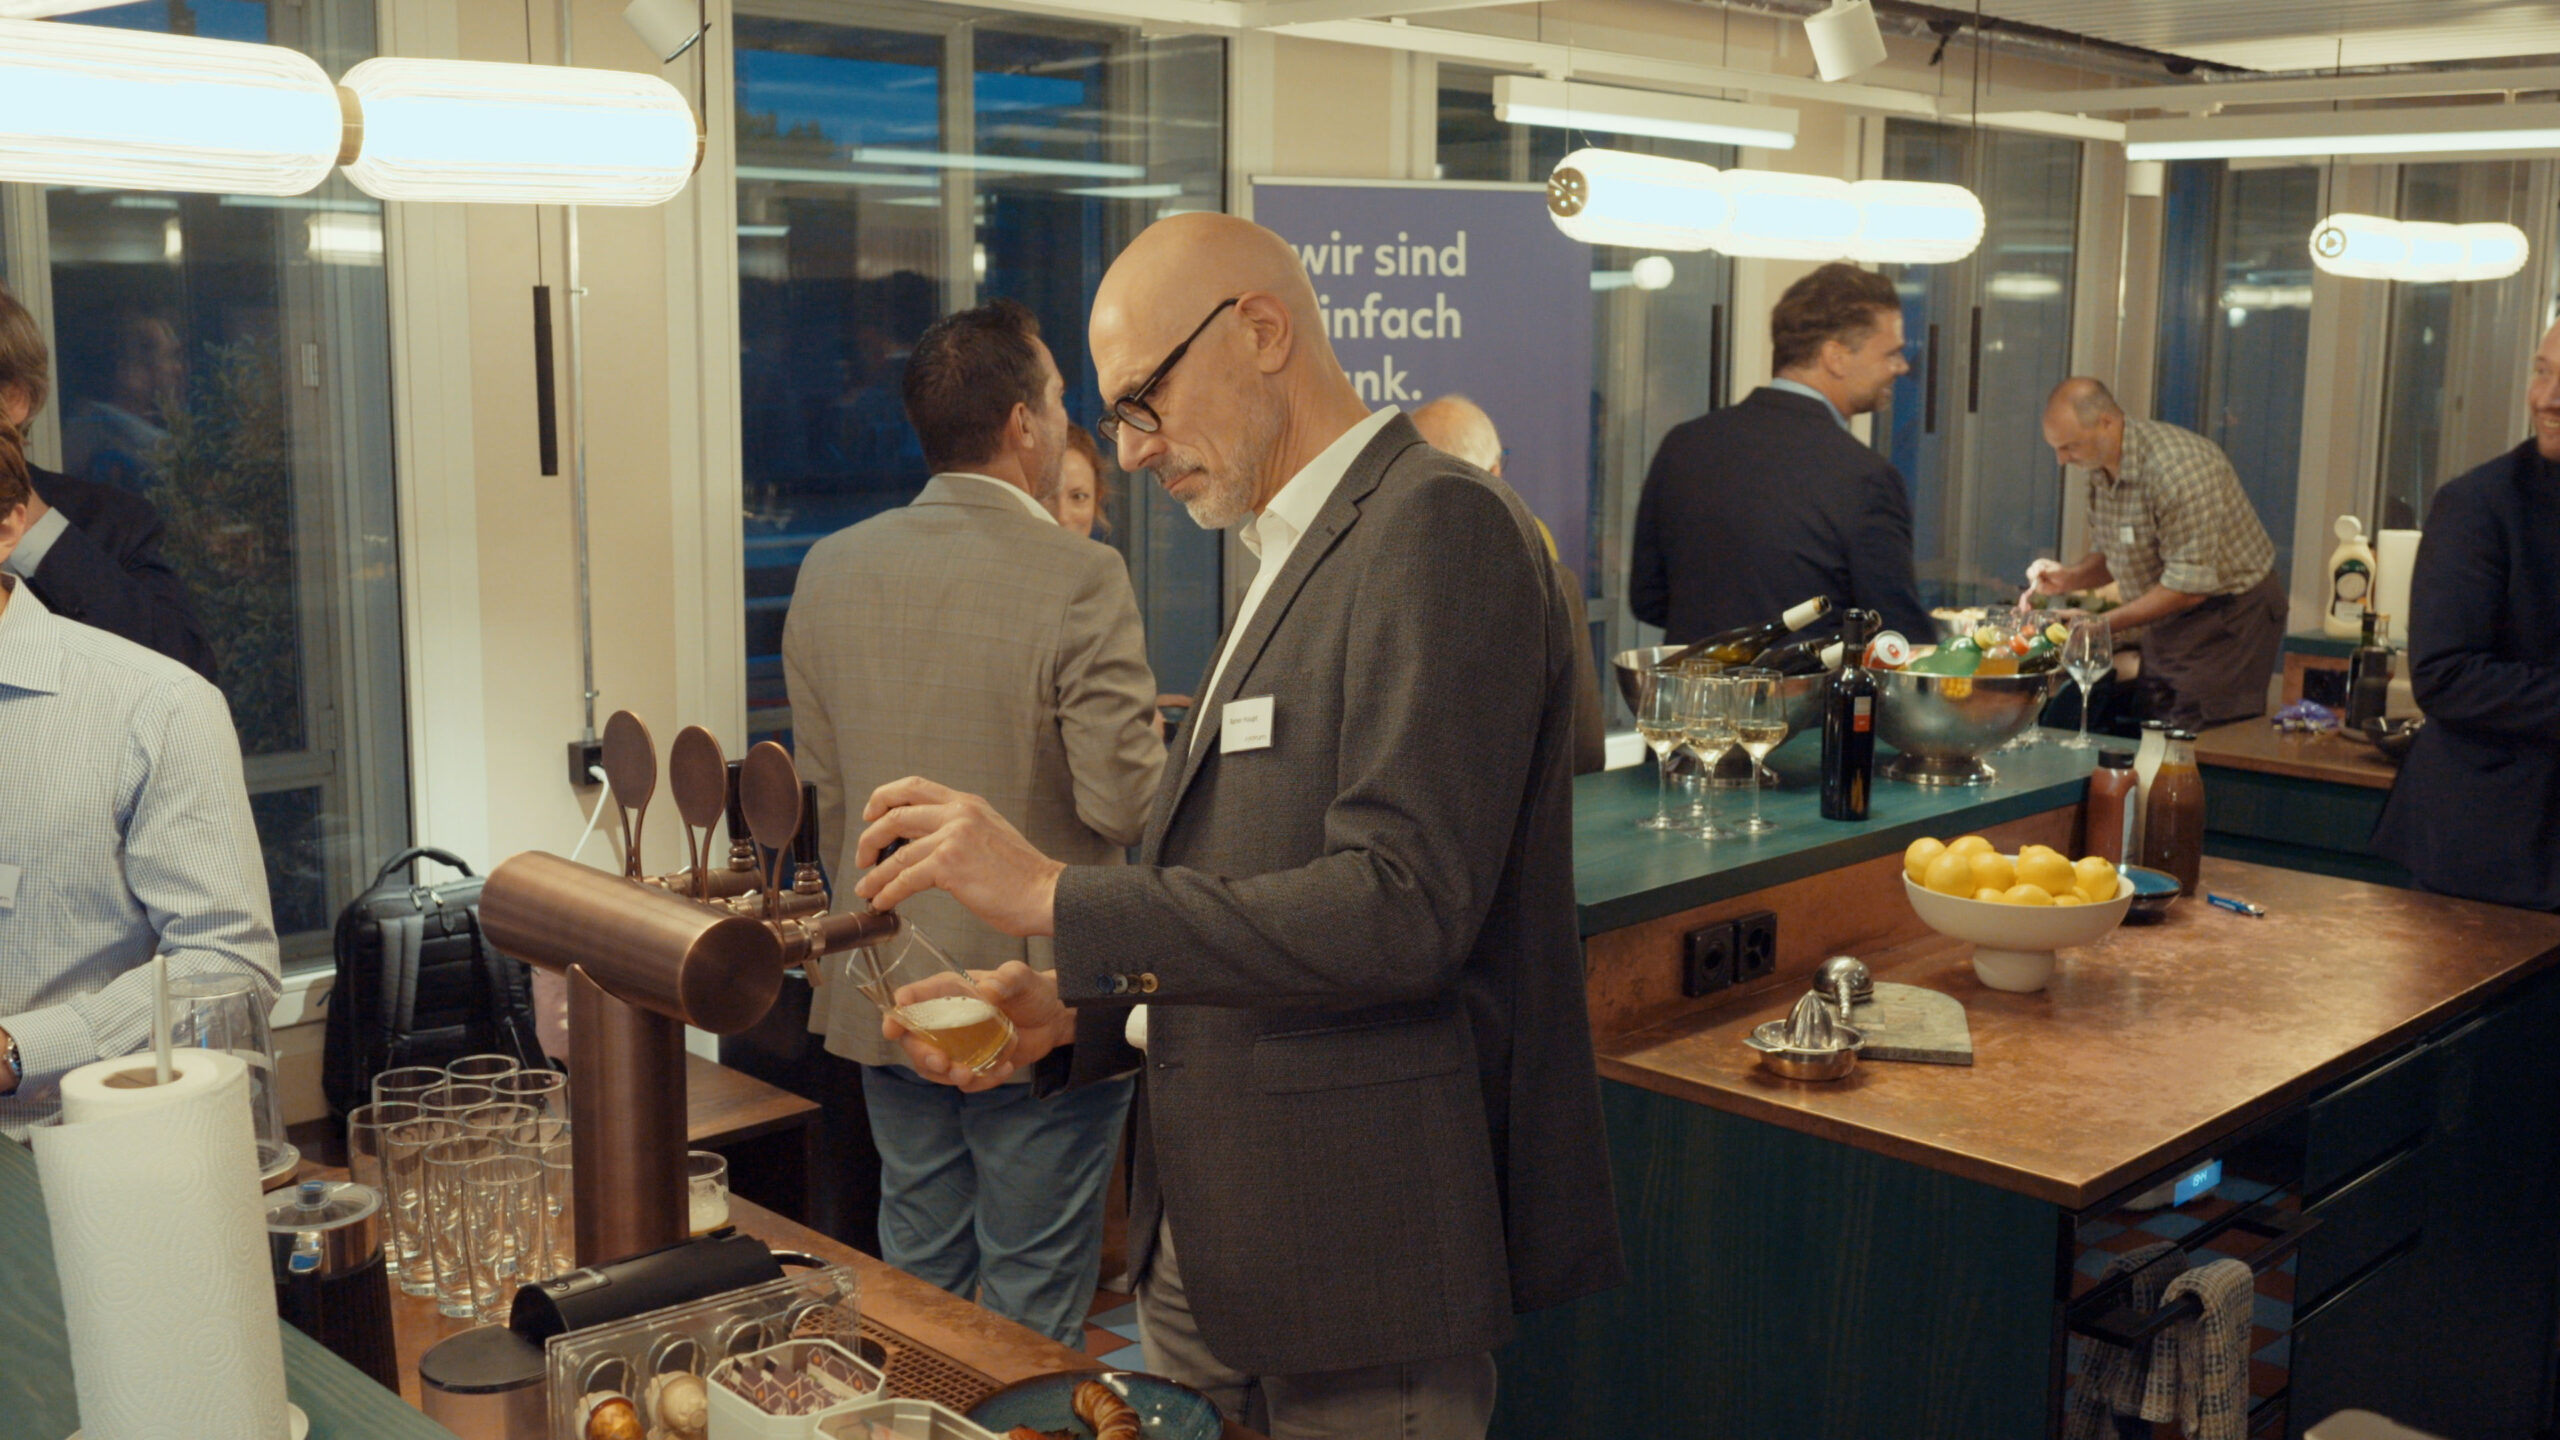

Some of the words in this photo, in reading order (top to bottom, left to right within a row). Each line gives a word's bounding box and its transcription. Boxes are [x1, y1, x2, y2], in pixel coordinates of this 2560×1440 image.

[1290, 230, 1363, 275] wir
[1374, 230, 1466, 277] sind
[1320, 292, 1461, 339] infach
[1345, 354, 1422, 401] nk.
